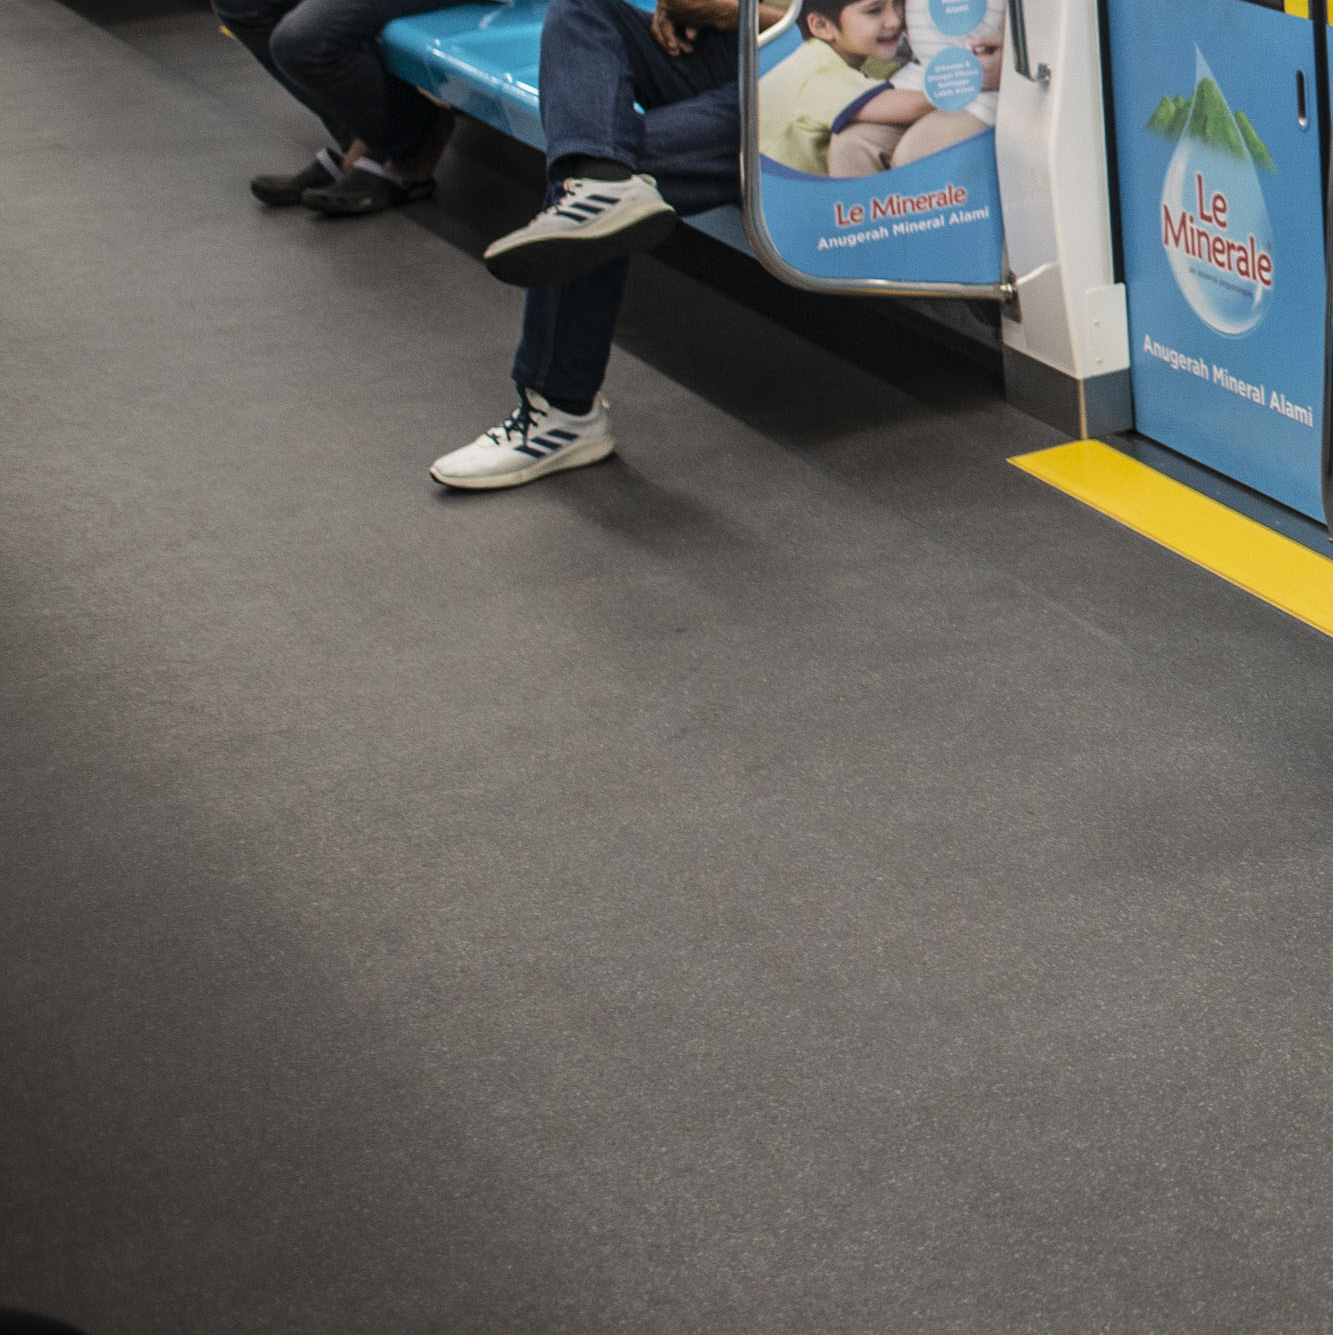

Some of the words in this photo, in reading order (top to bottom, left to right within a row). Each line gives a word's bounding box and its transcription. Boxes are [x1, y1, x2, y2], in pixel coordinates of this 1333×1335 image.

[818, 227, 889, 251] Anugerah
[893, 216, 945, 236] Mineral
[949, 206, 990, 226] Alami
[835, 203, 863, 227] Le
[871, 184, 967, 221] Minerale
[1197, 173, 1228, 229] Le
[1163, 204, 1273, 287] Minerale
[1143, 334, 1210, 380] Anugerah
[1212, 364, 1266, 406] Mineral
[1269, 390, 1314, 428] Alami
